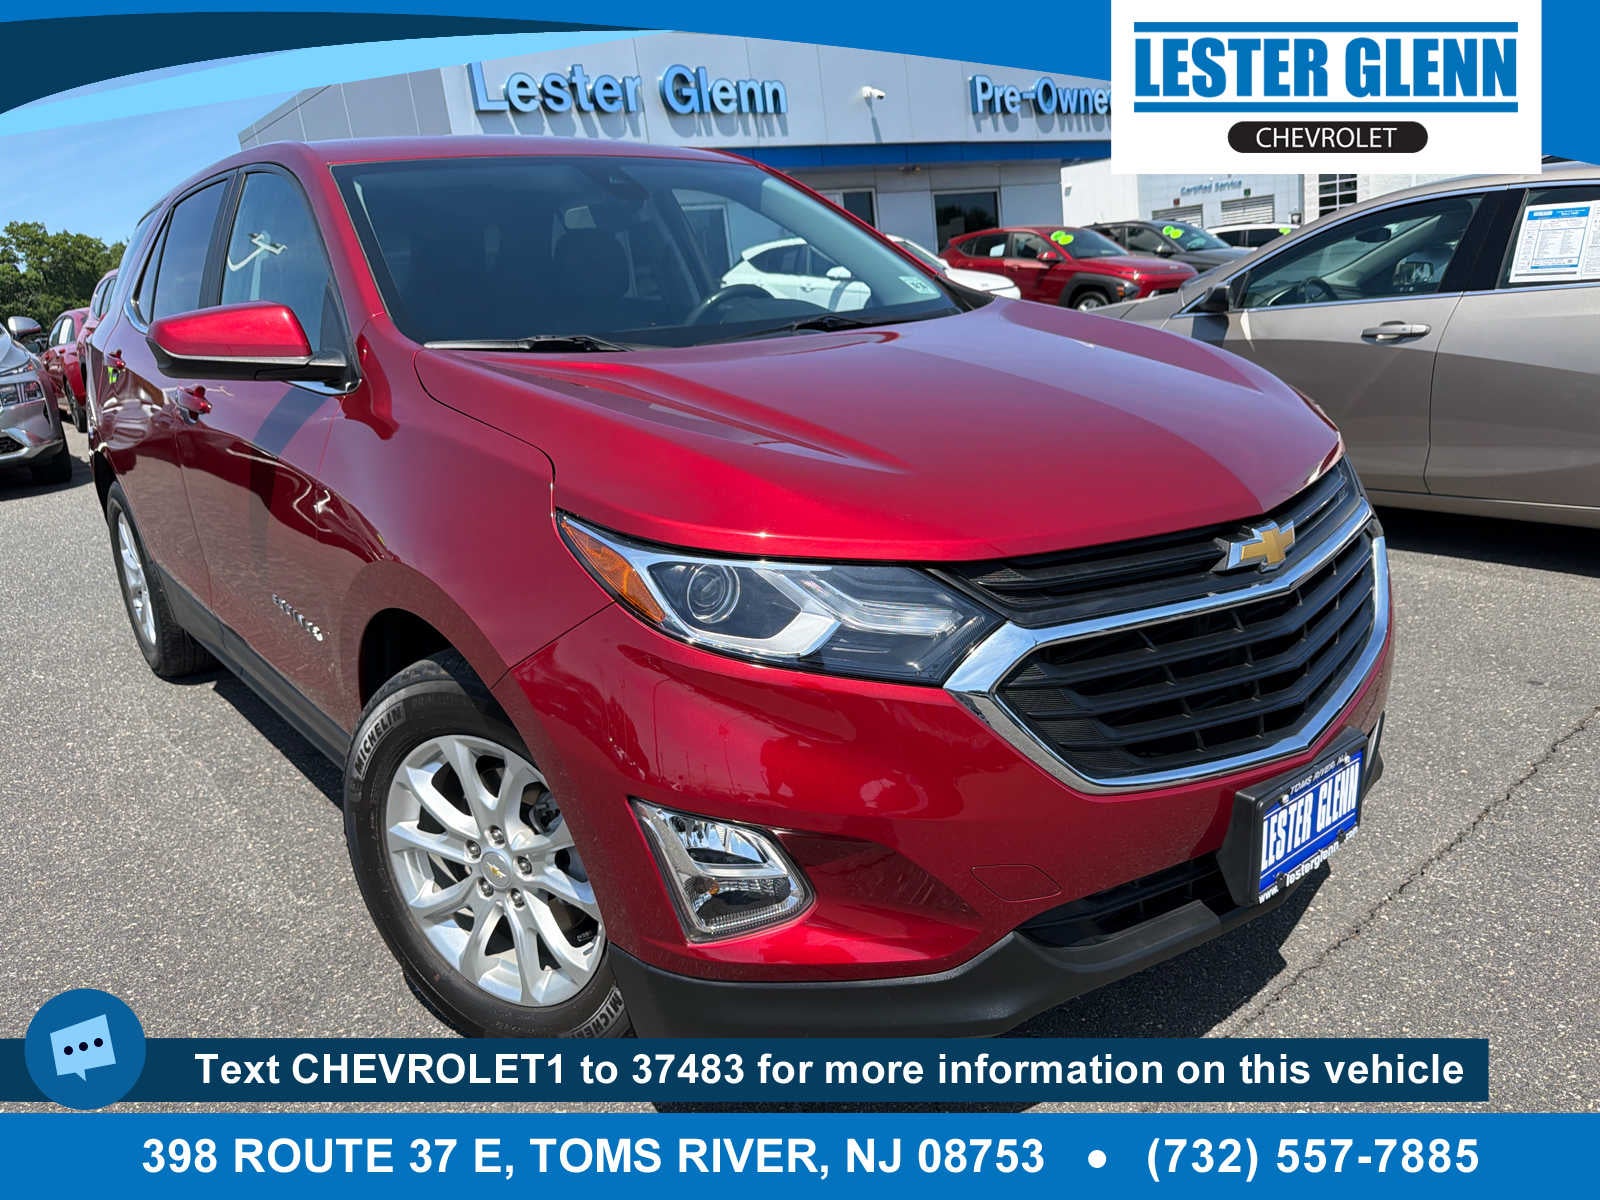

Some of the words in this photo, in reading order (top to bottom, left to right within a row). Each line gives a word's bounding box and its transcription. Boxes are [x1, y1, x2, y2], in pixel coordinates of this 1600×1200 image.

[467, 61, 641, 113] Lester
[659, 64, 788, 114] Glenn
[969, 74, 1111, 114] Pre-Owne
[355, 704, 404, 776] MICHELIN
[1261, 792, 1314, 872] LESTER
[1317, 762, 1360, 833] GLENN
